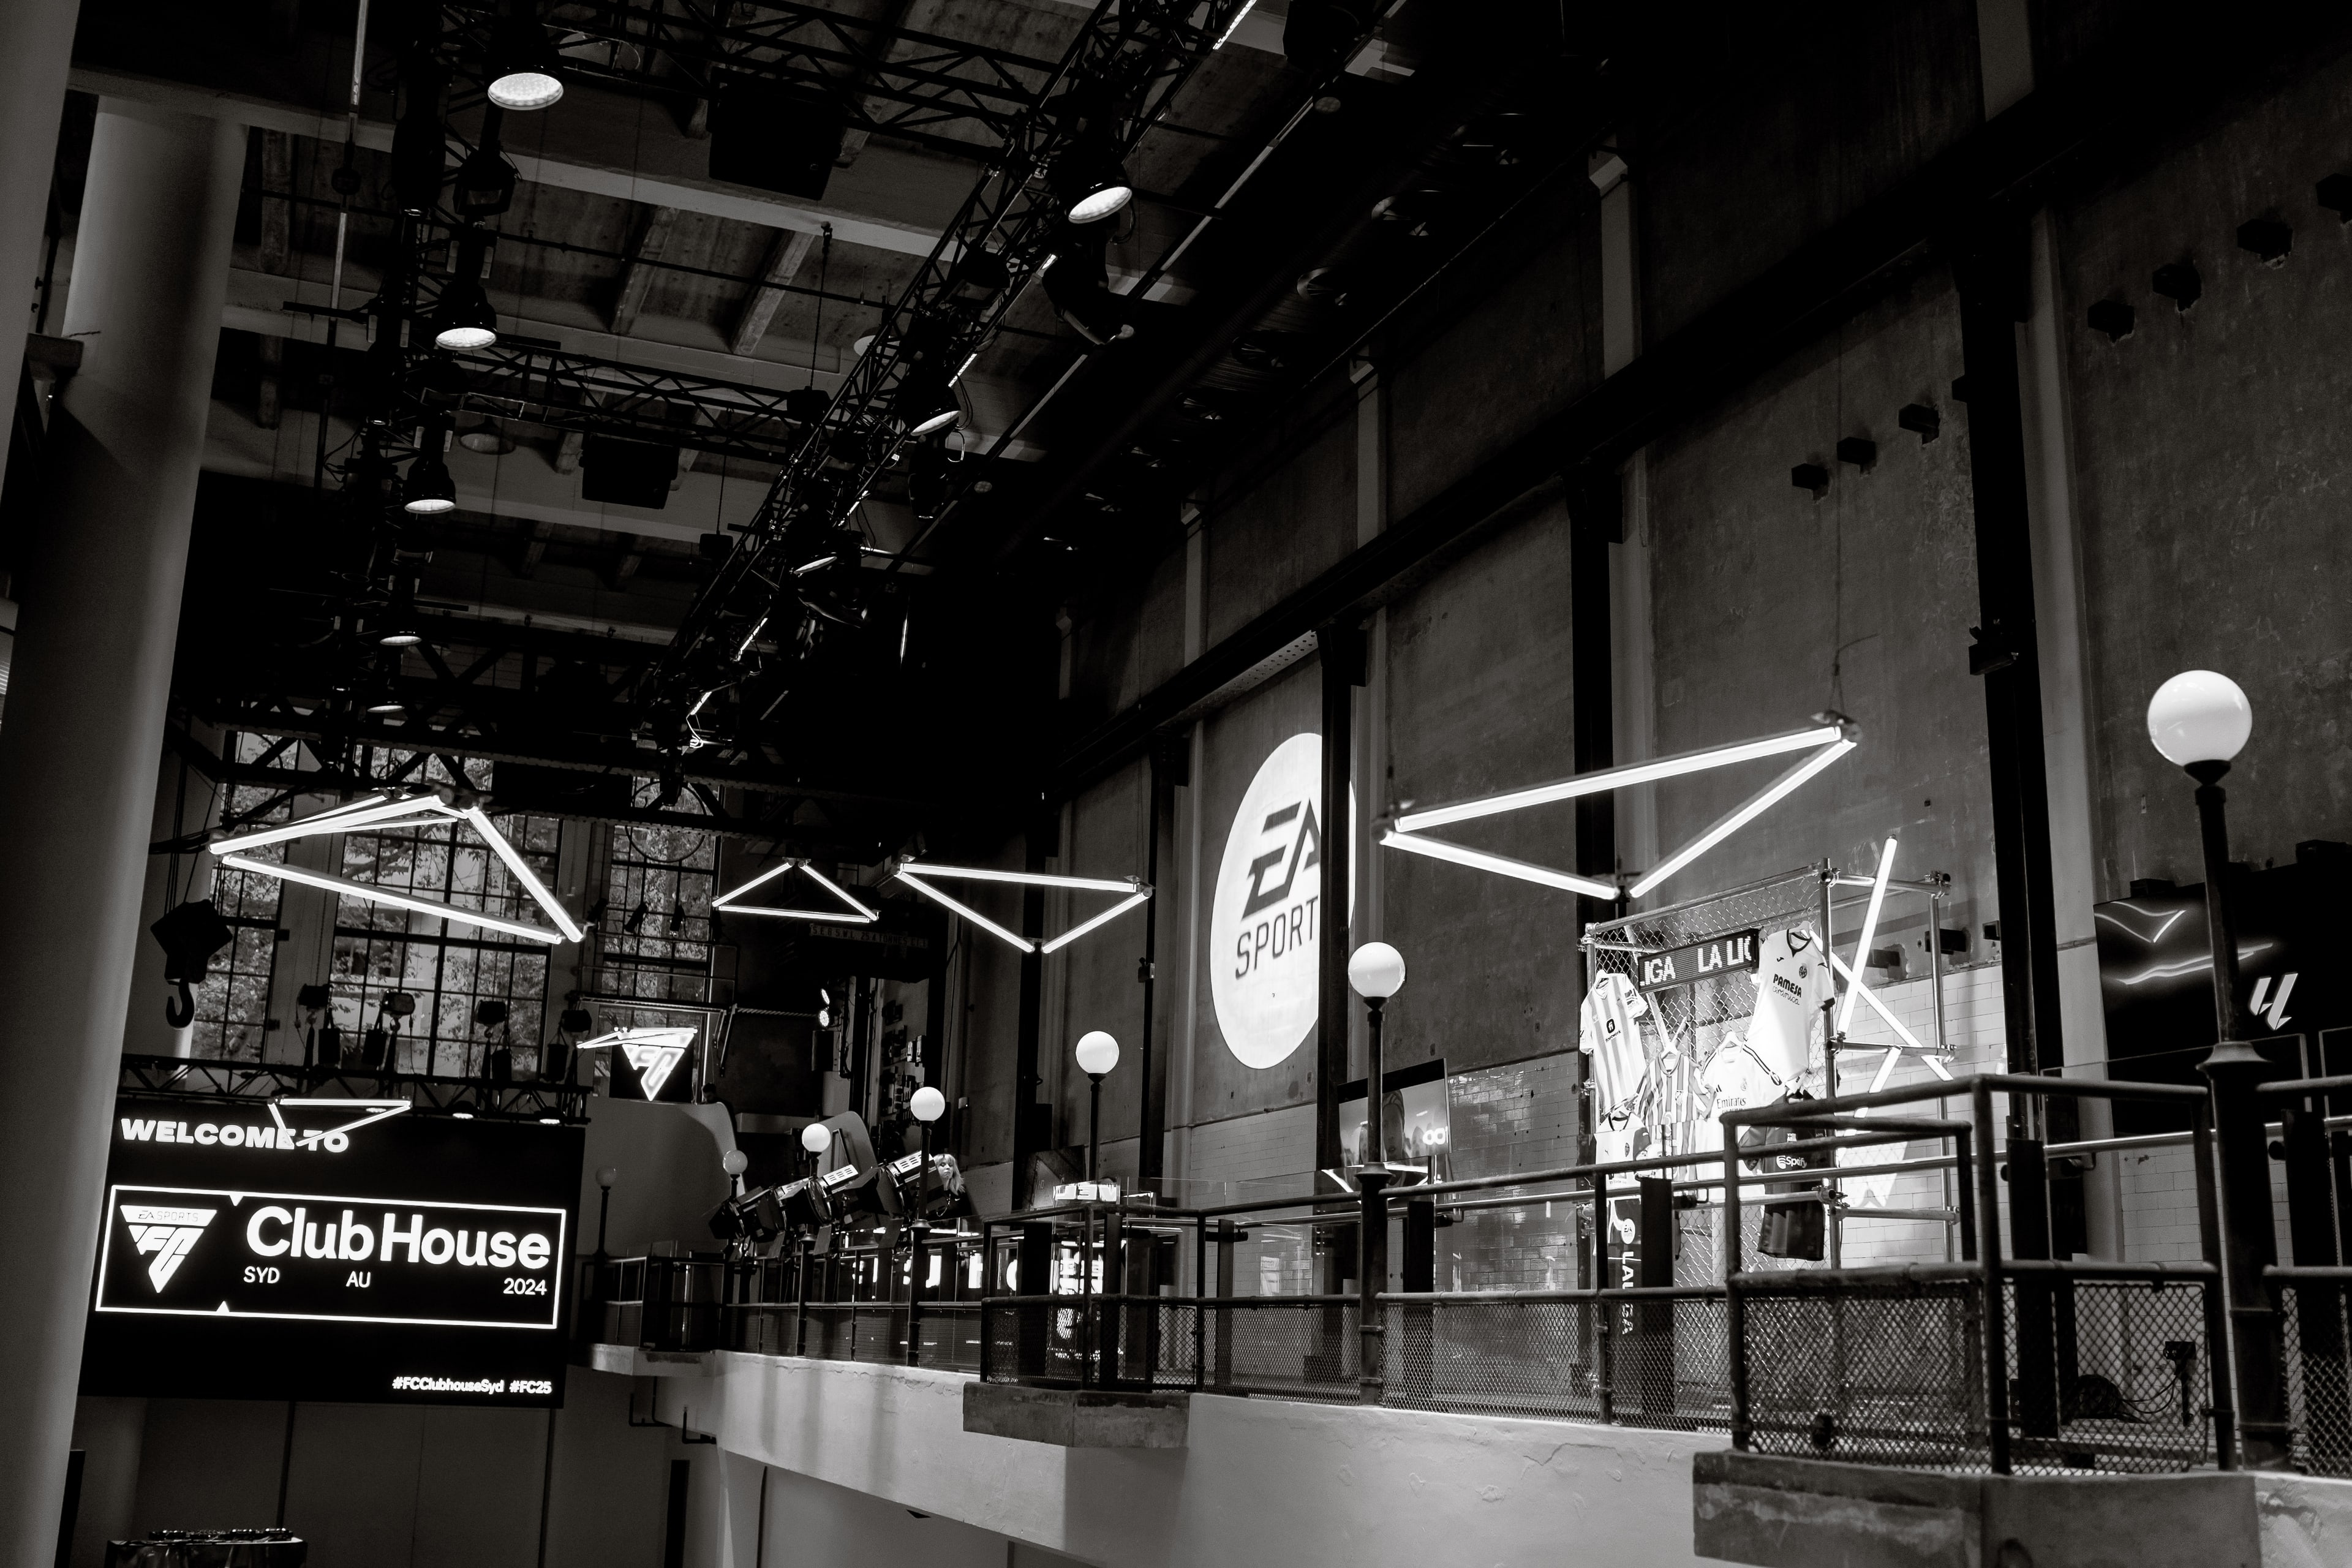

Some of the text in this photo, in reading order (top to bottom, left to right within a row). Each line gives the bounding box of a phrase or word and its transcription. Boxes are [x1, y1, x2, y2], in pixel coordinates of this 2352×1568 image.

[1640, 956, 1676, 986] IGA
[1697, 944, 1723, 973] LA
[1773, 973, 1802, 998] PAMESA
[121, 1118, 349, 1153] WELCOME TO
[138, 1210, 198, 1223] EA SPORTS
[246, 1205, 551, 1269] Club House
[243, 1266, 548, 1295] SYD AU 2024
[1622, 1251, 1634, 1335] LALGA
[392, 1377, 552, 1395] #FCClubhouseSyd #FC25
